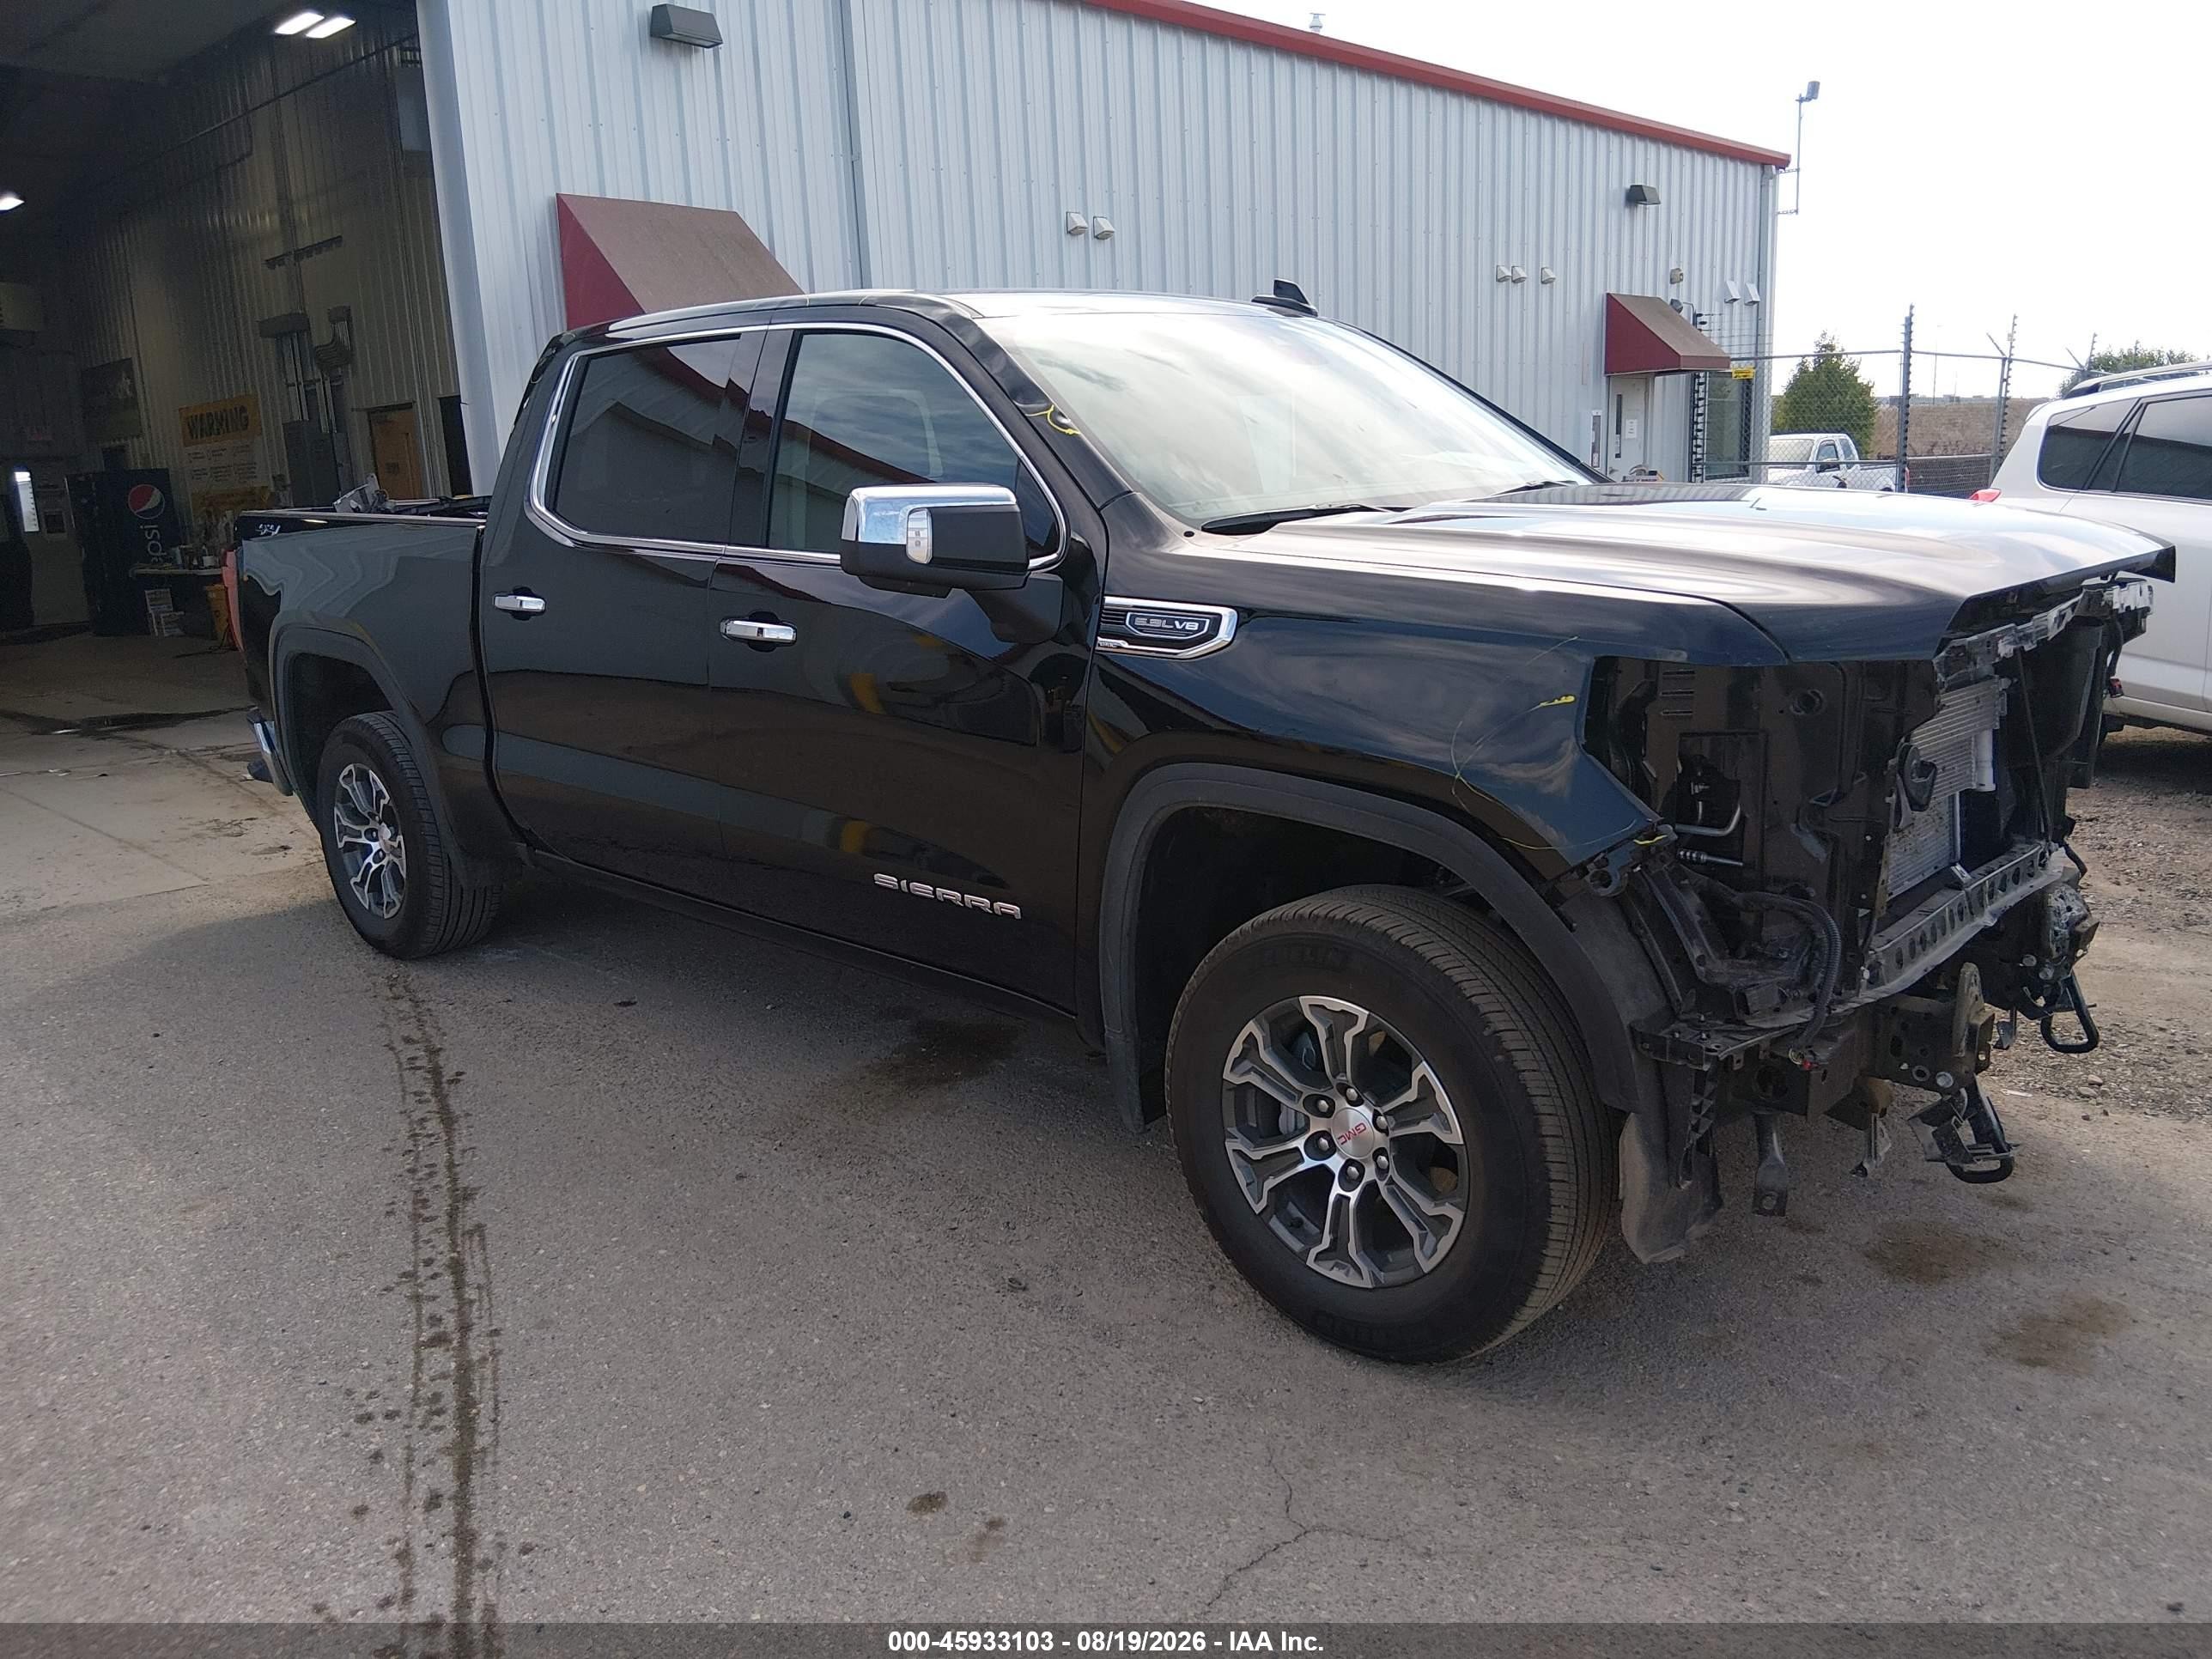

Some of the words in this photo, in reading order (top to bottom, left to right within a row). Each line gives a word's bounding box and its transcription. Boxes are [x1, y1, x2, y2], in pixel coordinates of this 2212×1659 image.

[187, 404, 249, 440] WARNING
[139, 524, 167, 563] psi
[873, 872, 1022, 920] SIERRA
[1337, 1122, 1367, 1146] GMC
